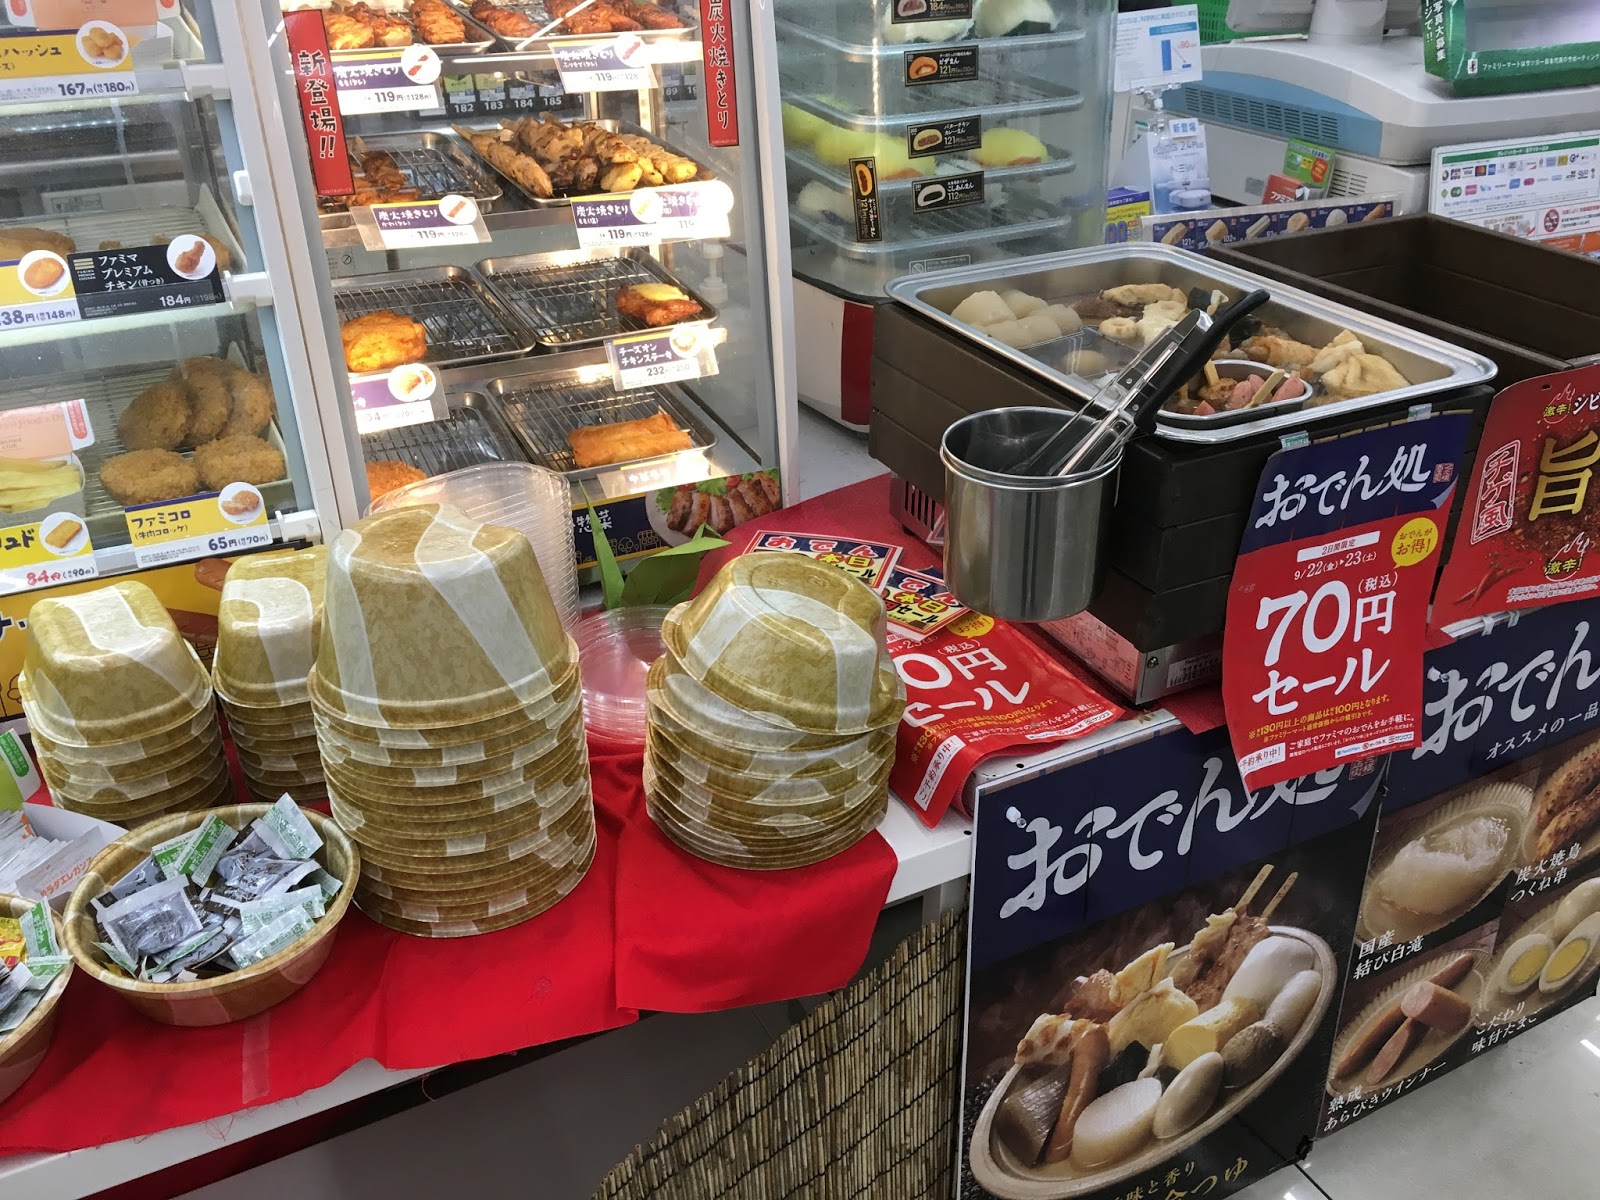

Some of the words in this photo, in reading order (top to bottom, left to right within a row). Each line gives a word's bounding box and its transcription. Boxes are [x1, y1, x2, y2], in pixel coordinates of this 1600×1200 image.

[0, 44, 62, 57] ハッシュ
[454, 103, 474, 113] 182
[484, 101, 504, 111] 183
[514, 99, 533, 108] 184
[543, 96, 562, 106] 185
[378, 208, 439, 222] 炭火焼きとり
[576, 204, 629, 217] 炭火焼きとり
[98, 253, 138, 266] ファミマ
[101, 264, 154, 280] プレミアム
[619, 343, 657, 356] チーズオン
[621, 350, 673, 367] チキンステーキ
[1254, 443, 1432, 529] おでん処
[1528, 430, 1600, 521] 旨
[1475, 449, 1515, 537] チゲ風
[131, 509, 192, 529] ファミコロ
[134, 524, 188, 540] (牛肉コロッケ)
[1399, 527, 1433, 540] おでんが
[765, 535, 878, 558] おでん
[1321, 538, 1356, 556] 2日間限定
[1395, 538, 1431, 556] お得!
[818, 552, 870, 568] 本日
[1357, 571, 1399, 594] (税込)
[895, 592, 944, 614] 本日
[1255, 580, 1397, 667] 70円
[937, 639, 981, 656] (税込)
[1251, 648, 1390, 716] セール
[1486, 701, 1599, 760] オススメの一品
[1238, 746, 1281, 771] 予約承り中!
[1514, 842, 1582, 886] 炭火焼鳥
[1511, 866, 1568, 903] つくね串
[1358, 929, 1396, 960] 国産
[1352, 935, 1425, 980] 結び白滝
[1475, 1001, 1526, 1035] こだわり
[1471, 1007, 1543, 1053] 味付たまご
[1323, 1061, 1447, 1132] あらびきウインナー
[1327, 1084, 1363, 1115] 熟成
[1115, 1161, 1195, 1200] 味と香り
